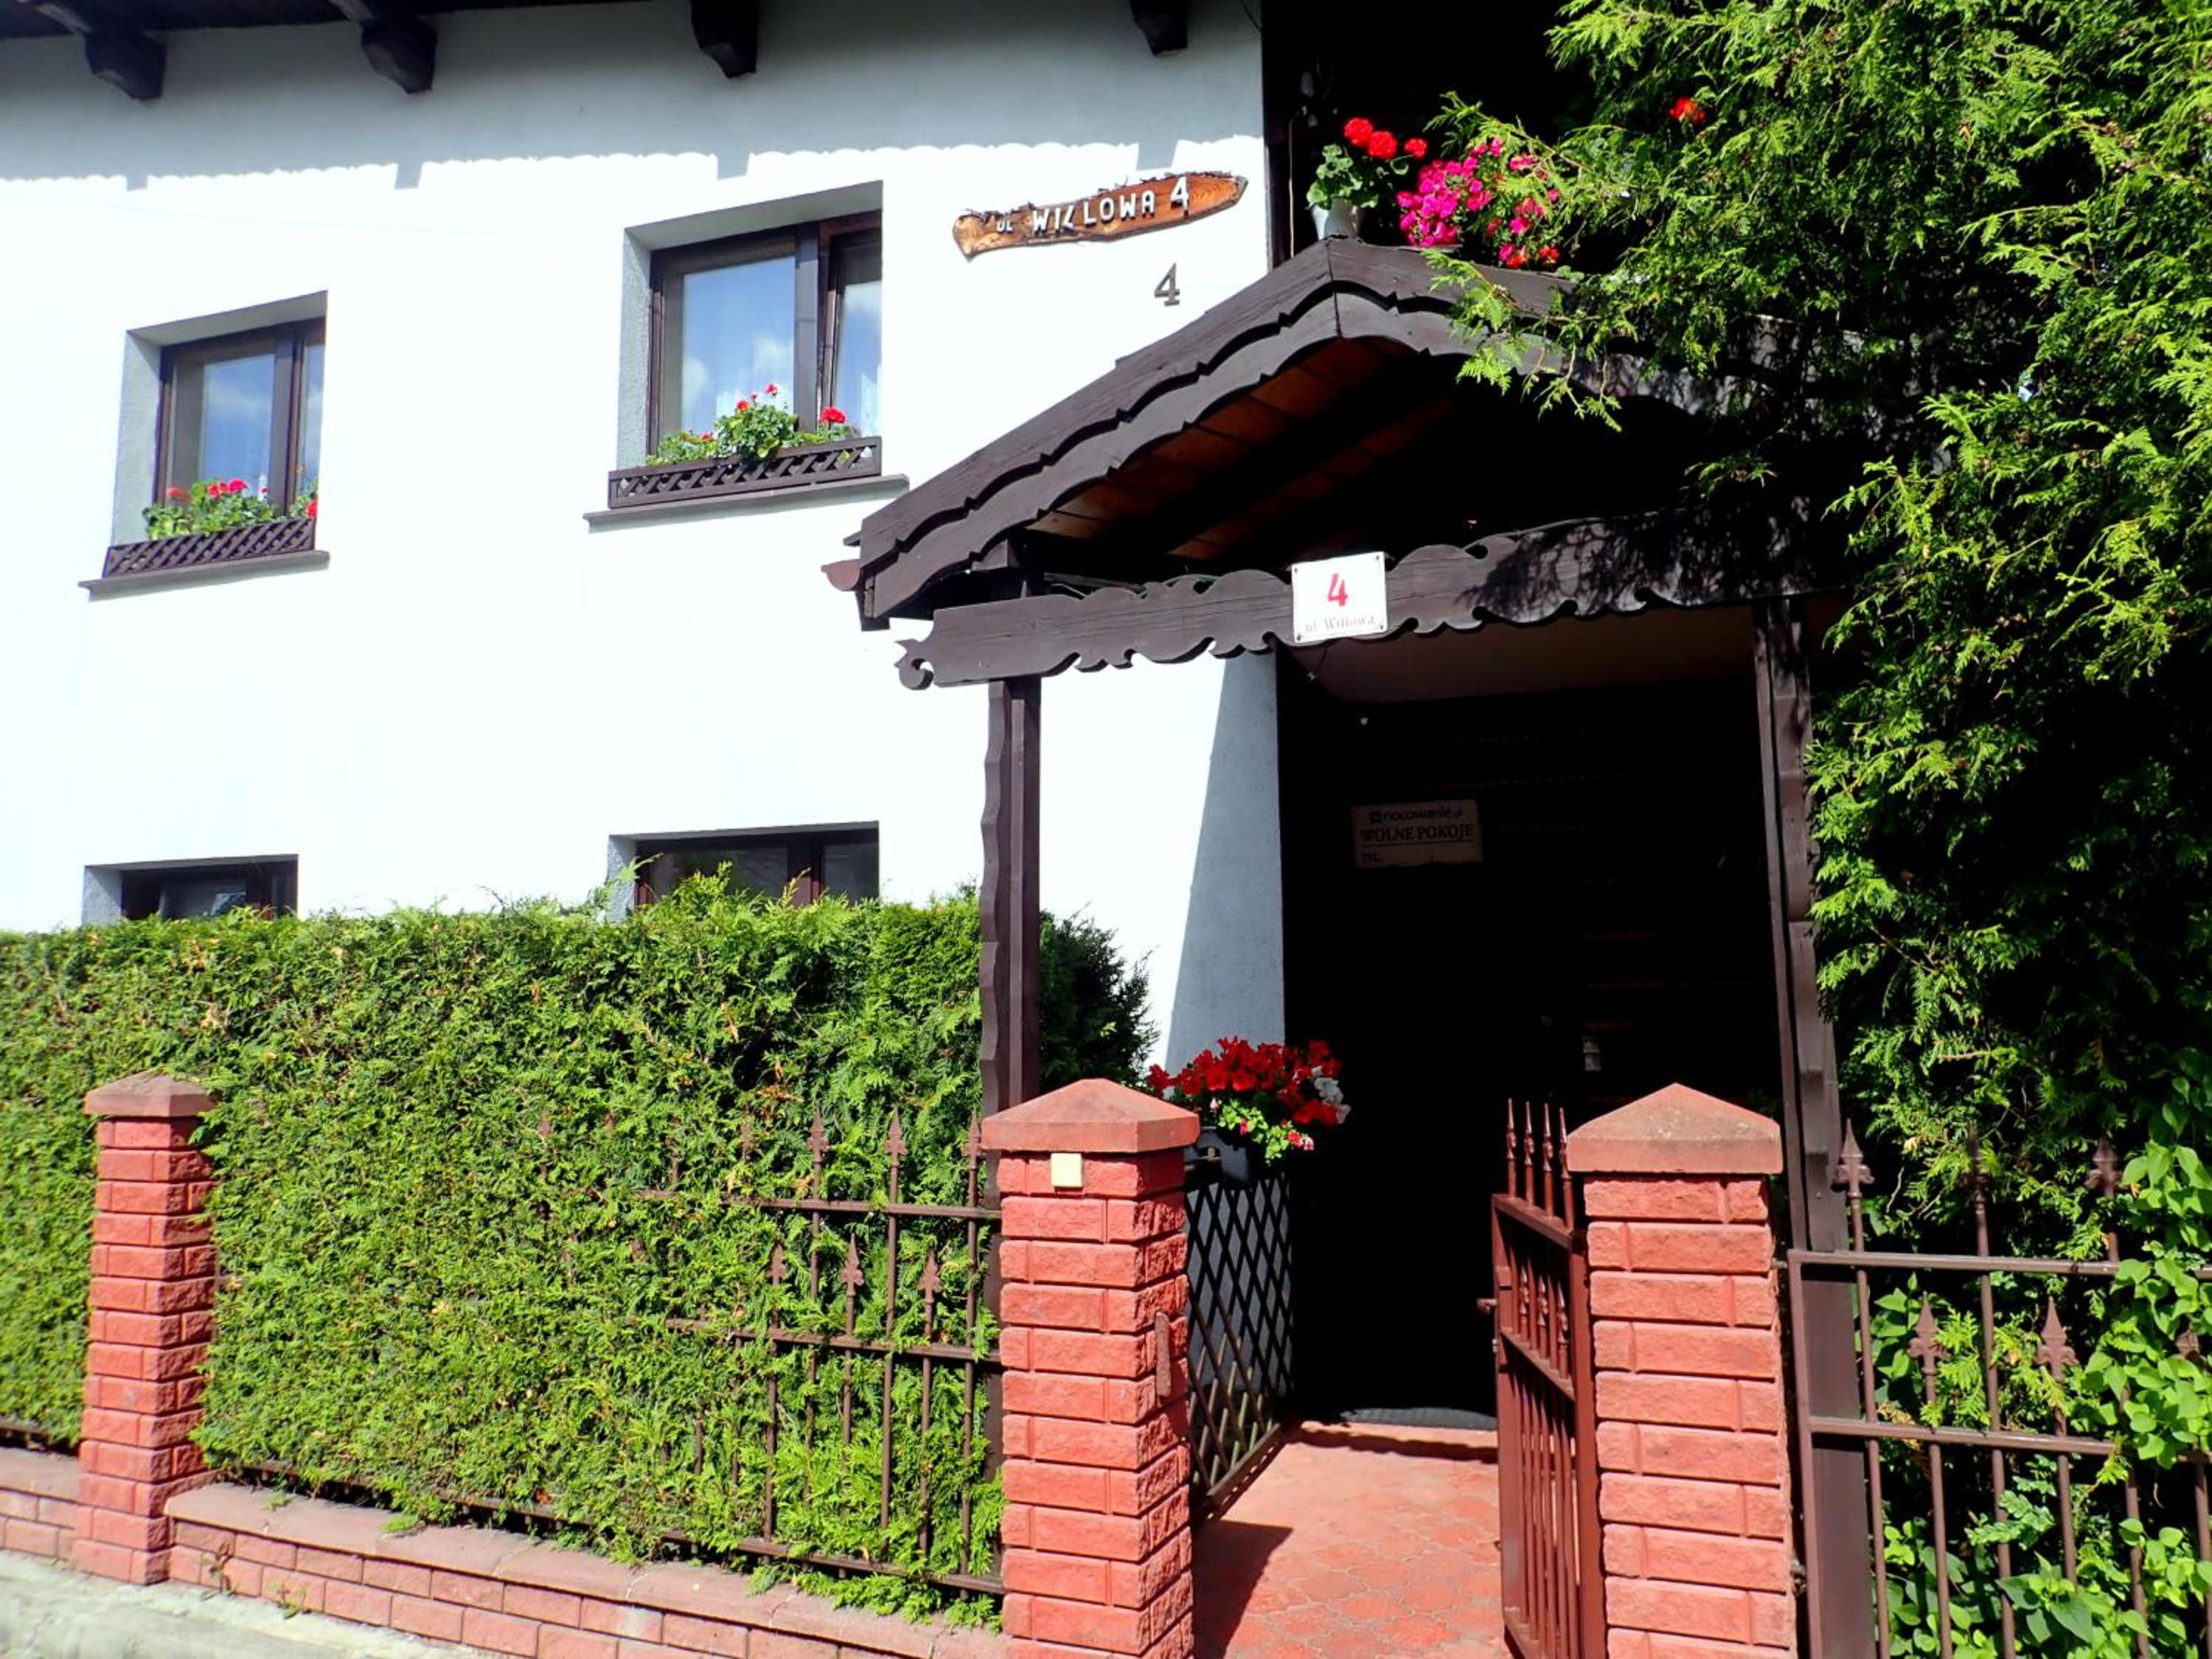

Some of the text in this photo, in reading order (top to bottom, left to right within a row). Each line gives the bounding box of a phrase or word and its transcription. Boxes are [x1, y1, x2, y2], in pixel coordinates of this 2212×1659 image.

[1170, 175, 1190, 212] 4
[1153, 262, 1180, 307] 4
[1326, 572, 1349, 608] 4
[1360, 823, 1475, 842] WOLNE POKOJE
